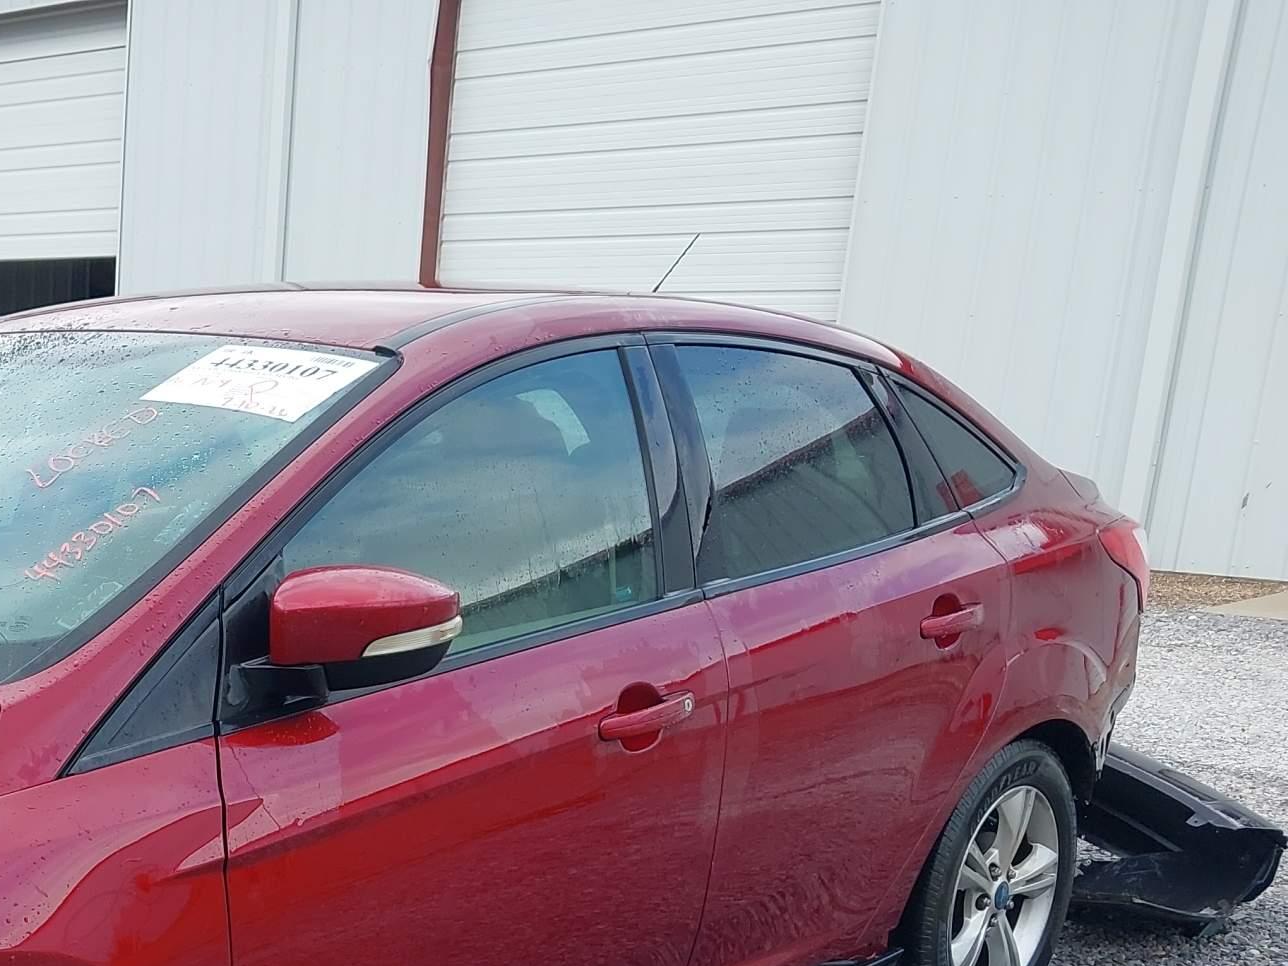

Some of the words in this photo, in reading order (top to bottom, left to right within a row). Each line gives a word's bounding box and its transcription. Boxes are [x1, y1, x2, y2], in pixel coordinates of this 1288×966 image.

[210, 356, 338, 381] 44330107
[26, 407, 158, 488] LOCKED
[24, 487, 161, 583] 44330107
